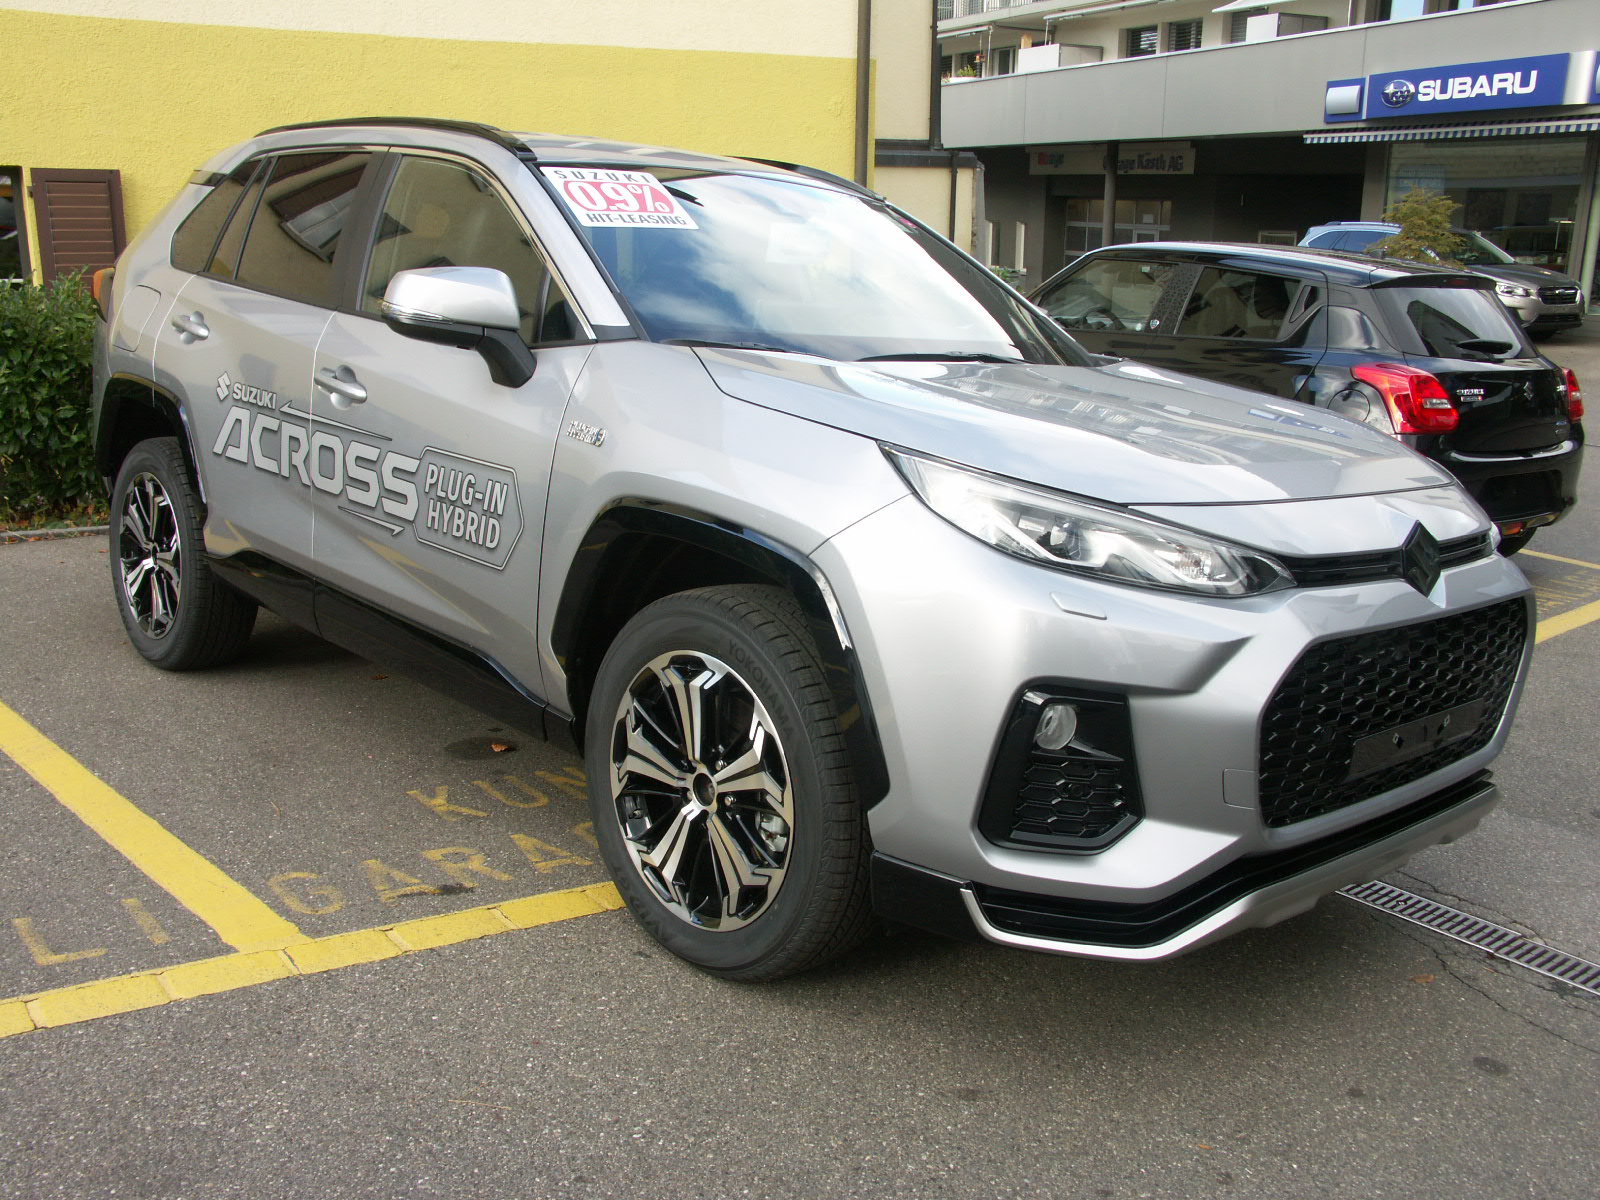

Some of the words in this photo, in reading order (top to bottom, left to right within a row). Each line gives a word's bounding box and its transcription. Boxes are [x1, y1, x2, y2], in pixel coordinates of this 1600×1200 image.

[1417, 69, 1538, 102] SUBARU
[554, 170, 651, 183] SUZUKI
[567, 181, 671, 213] 0.9%
[586, 213, 687, 226] HIT-LEASING
[232, 382, 278, 410] SUZUKI
[212, 405, 421, 522] ACROSS
[424, 463, 509, 516] PLUG-IN
[426, 499, 501, 550] HYBRID
[729, 640, 793, 739] YOKOHAMA
